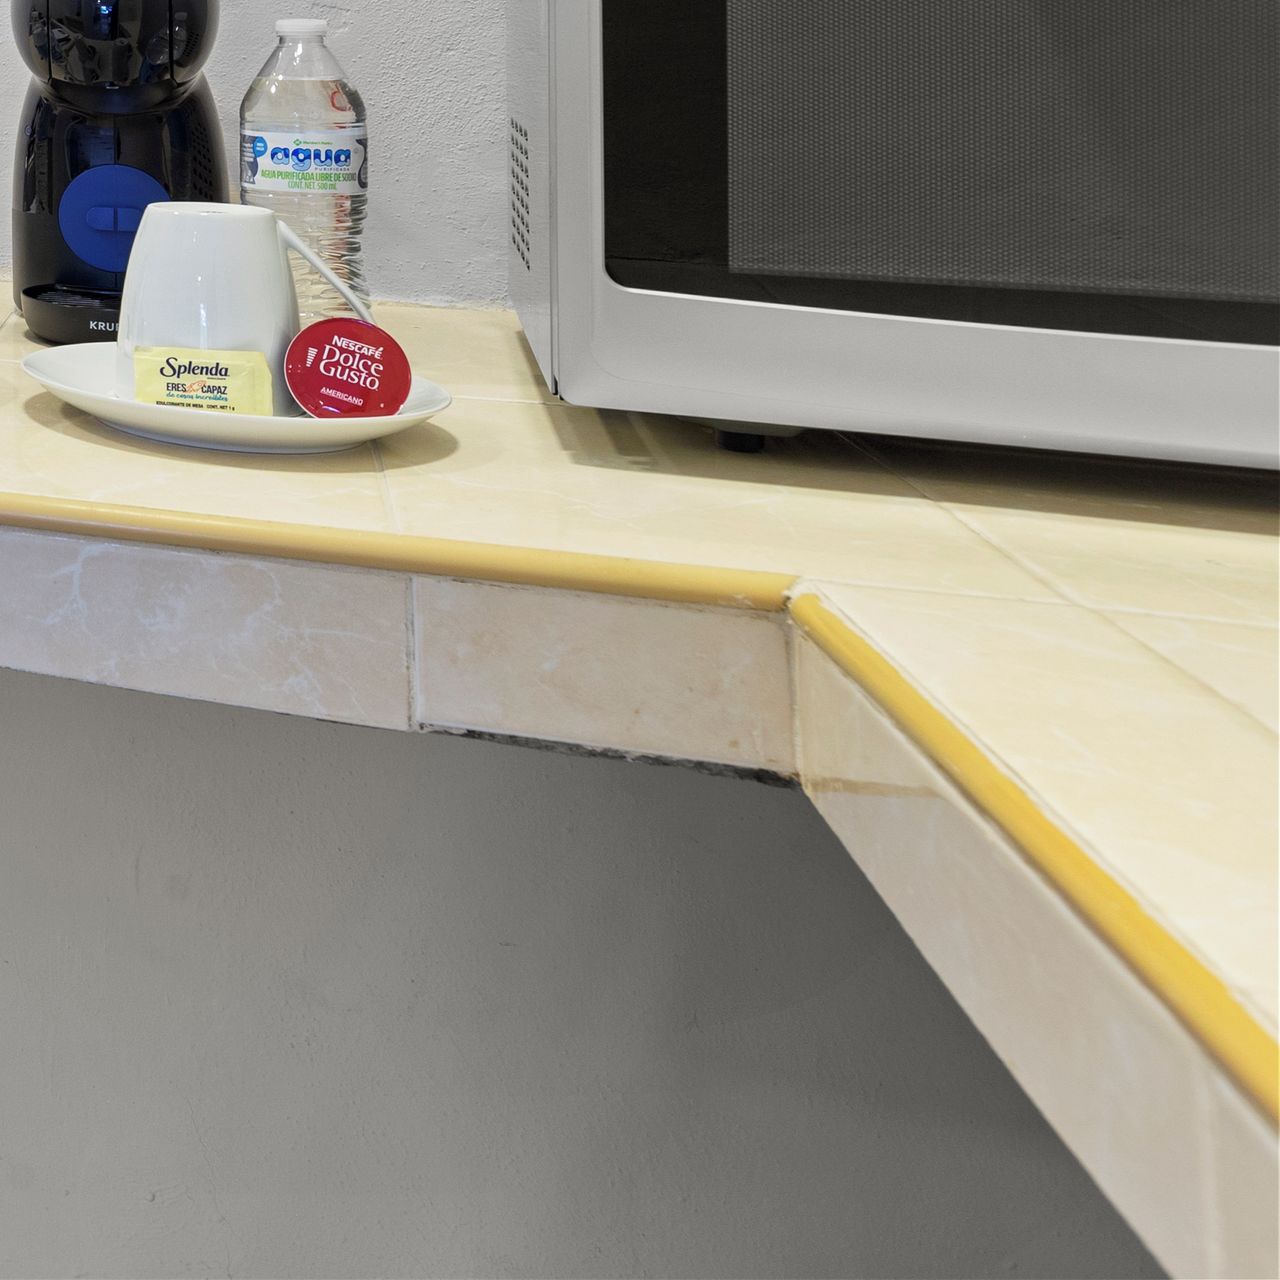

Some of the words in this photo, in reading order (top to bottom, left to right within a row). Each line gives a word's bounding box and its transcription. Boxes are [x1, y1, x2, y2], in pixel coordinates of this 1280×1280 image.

[270, 146, 351, 172] agua
[261, 169, 276, 179] AGUA
[276, 170, 314, 181] PURIFICADA
[315, 172, 333, 182] LIBRE
[333, 172, 341, 182] DE
[341, 172, 357, 182] SODIO
[318, 181, 328, 190] 500
[331, 335, 384, 360] NESCAFÉ
[159, 356, 229, 379] Splenda
[321, 343, 384, 378] Dolce
[319, 359, 380, 391] Gusto
[166, 382, 187, 393] ERES
[201, 384, 228, 395] CAPAZ
[320, 386, 364, 406] AMERICANO
